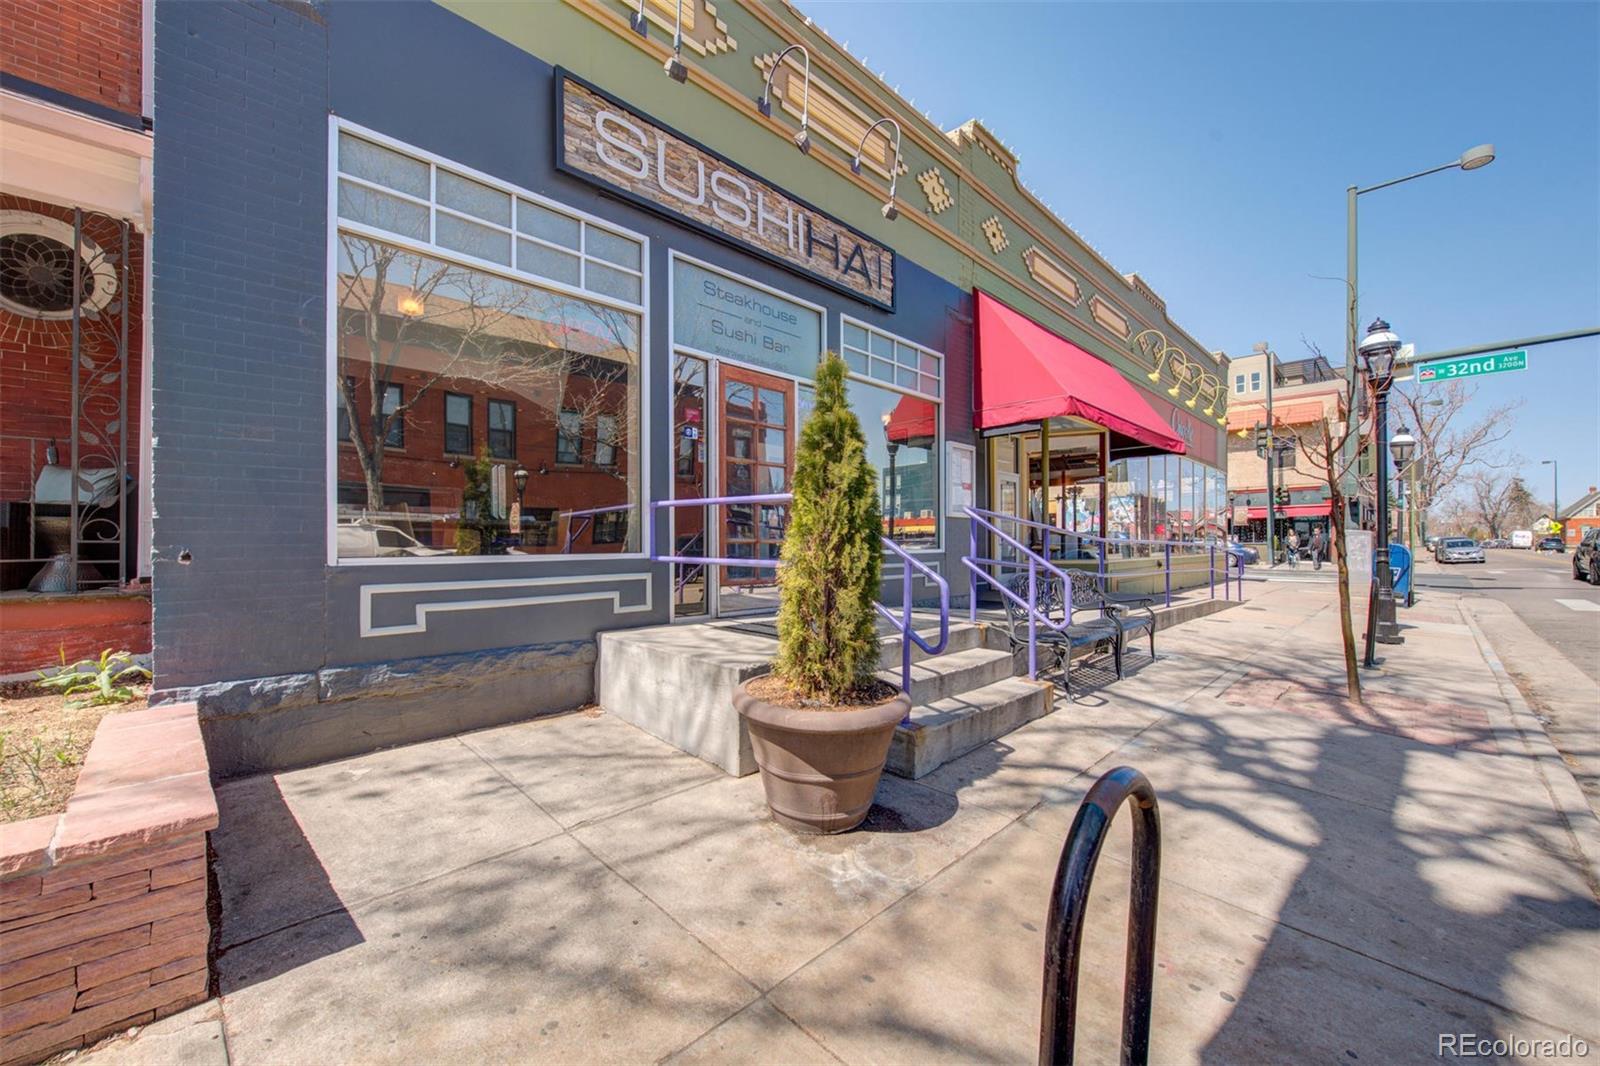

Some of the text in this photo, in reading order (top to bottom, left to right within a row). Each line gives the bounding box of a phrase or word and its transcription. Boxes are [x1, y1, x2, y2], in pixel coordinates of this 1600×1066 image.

[703, 279, 798, 326] Steakhouse
[743, 316, 762, 328] and
[711, 319, 791, 353] Sushi Bar
[1446, 357, 1495, 377] 32nd
